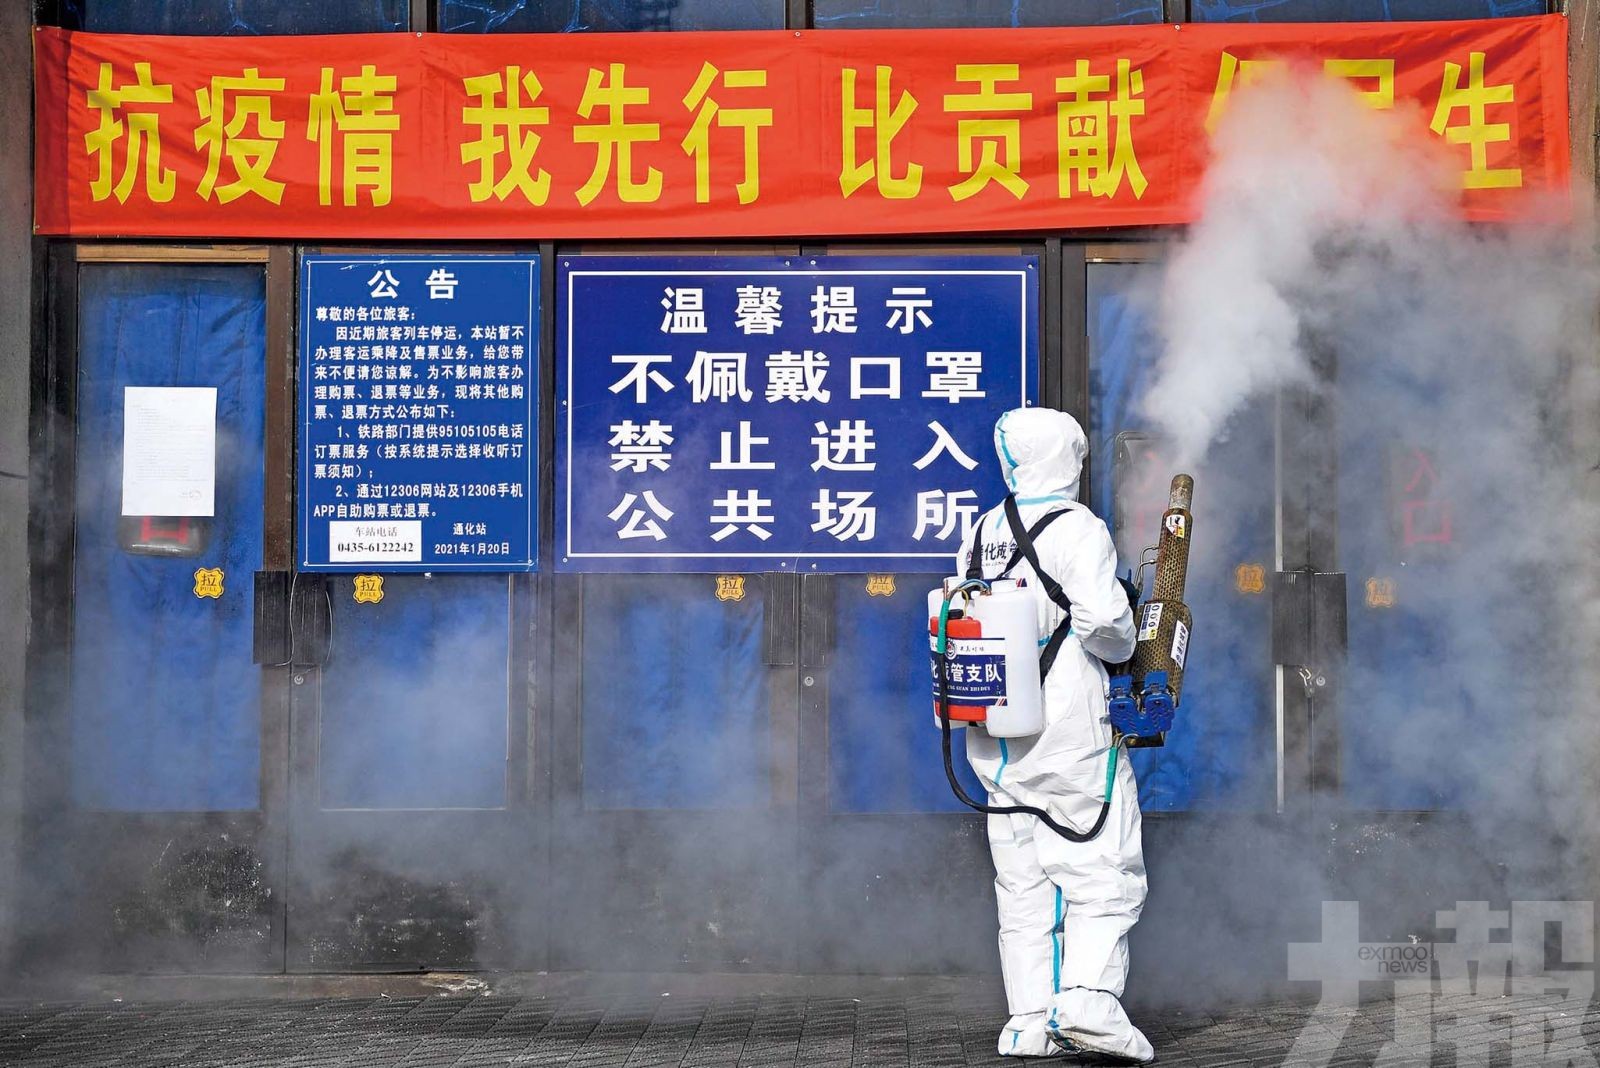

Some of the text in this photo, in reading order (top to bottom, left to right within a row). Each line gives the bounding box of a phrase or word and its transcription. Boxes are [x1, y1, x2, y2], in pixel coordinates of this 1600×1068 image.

[84, 62, 401, 207] 抗疫情
[460, 61, 774, 207] 我先行
[838, 58, 1149, 202] 比贡献
[367, 268, 459, 300] 公告
[660, 284, 933, 335] 温馨提示
[608, 350, 986, 404] 不佩戴口罩
[607, 420, 979, 473] 禁止进入
[607, 488, 979, 542] 公共场所
[453, 522, 487, 535] 通化站
[338, 542, 414, 552] 0435-6122242
[434, 542, 510, 555] 2021年1月20日
[201, 573, 217, 586] 拉
[360, 578, 377, 591] 拉
[722, 576, 739, 589] 拉
